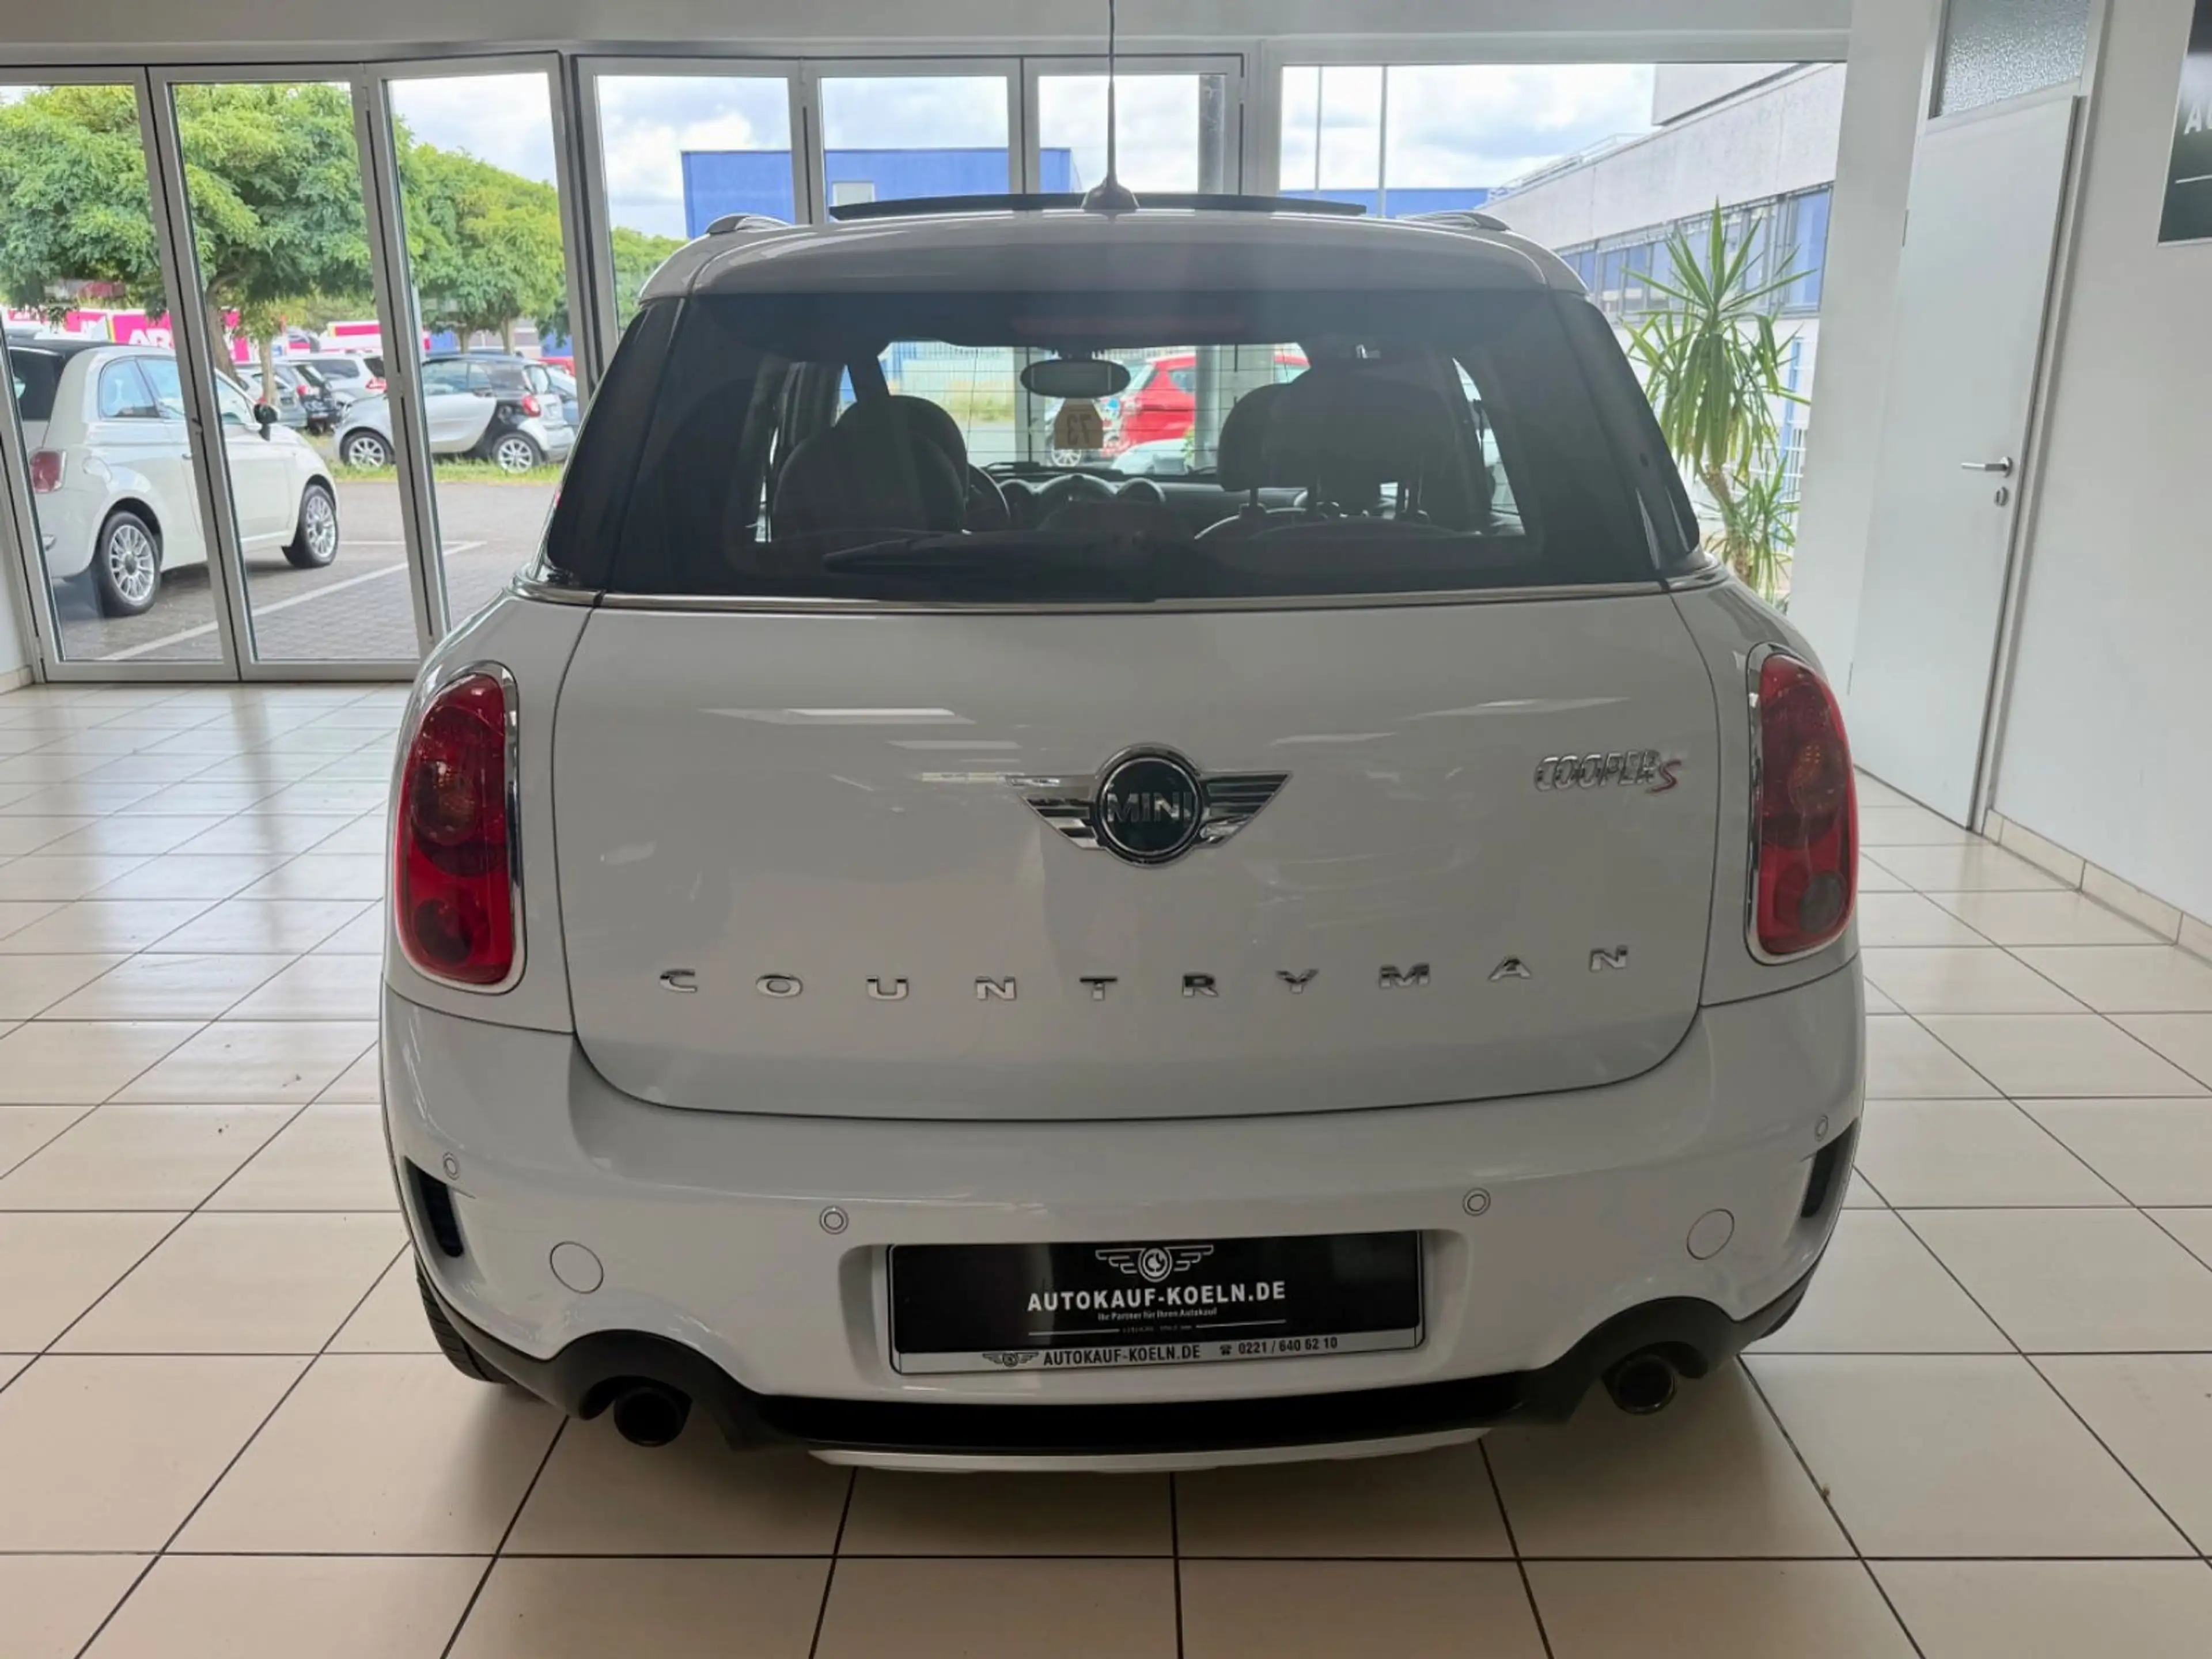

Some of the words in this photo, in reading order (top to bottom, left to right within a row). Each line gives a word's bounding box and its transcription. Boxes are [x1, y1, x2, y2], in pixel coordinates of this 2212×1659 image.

[1107, 791, 1192, 823] MINI
[660, 945, 1628, 1001] COUNTRYMAN
[1028, 1281, 1286, 1312] AUTOKAUF-KOELN.DE
[1043, 1344, 1200, 1365] AUTOKAUF-KOELN.DE
[1238, 1342, 1267, 1354] 0221
[1279, 1339, 1301, 1351] 640
[1305, 1338, 1319, 1350] 62
[1323, 1336, 1338, 1349] 10
